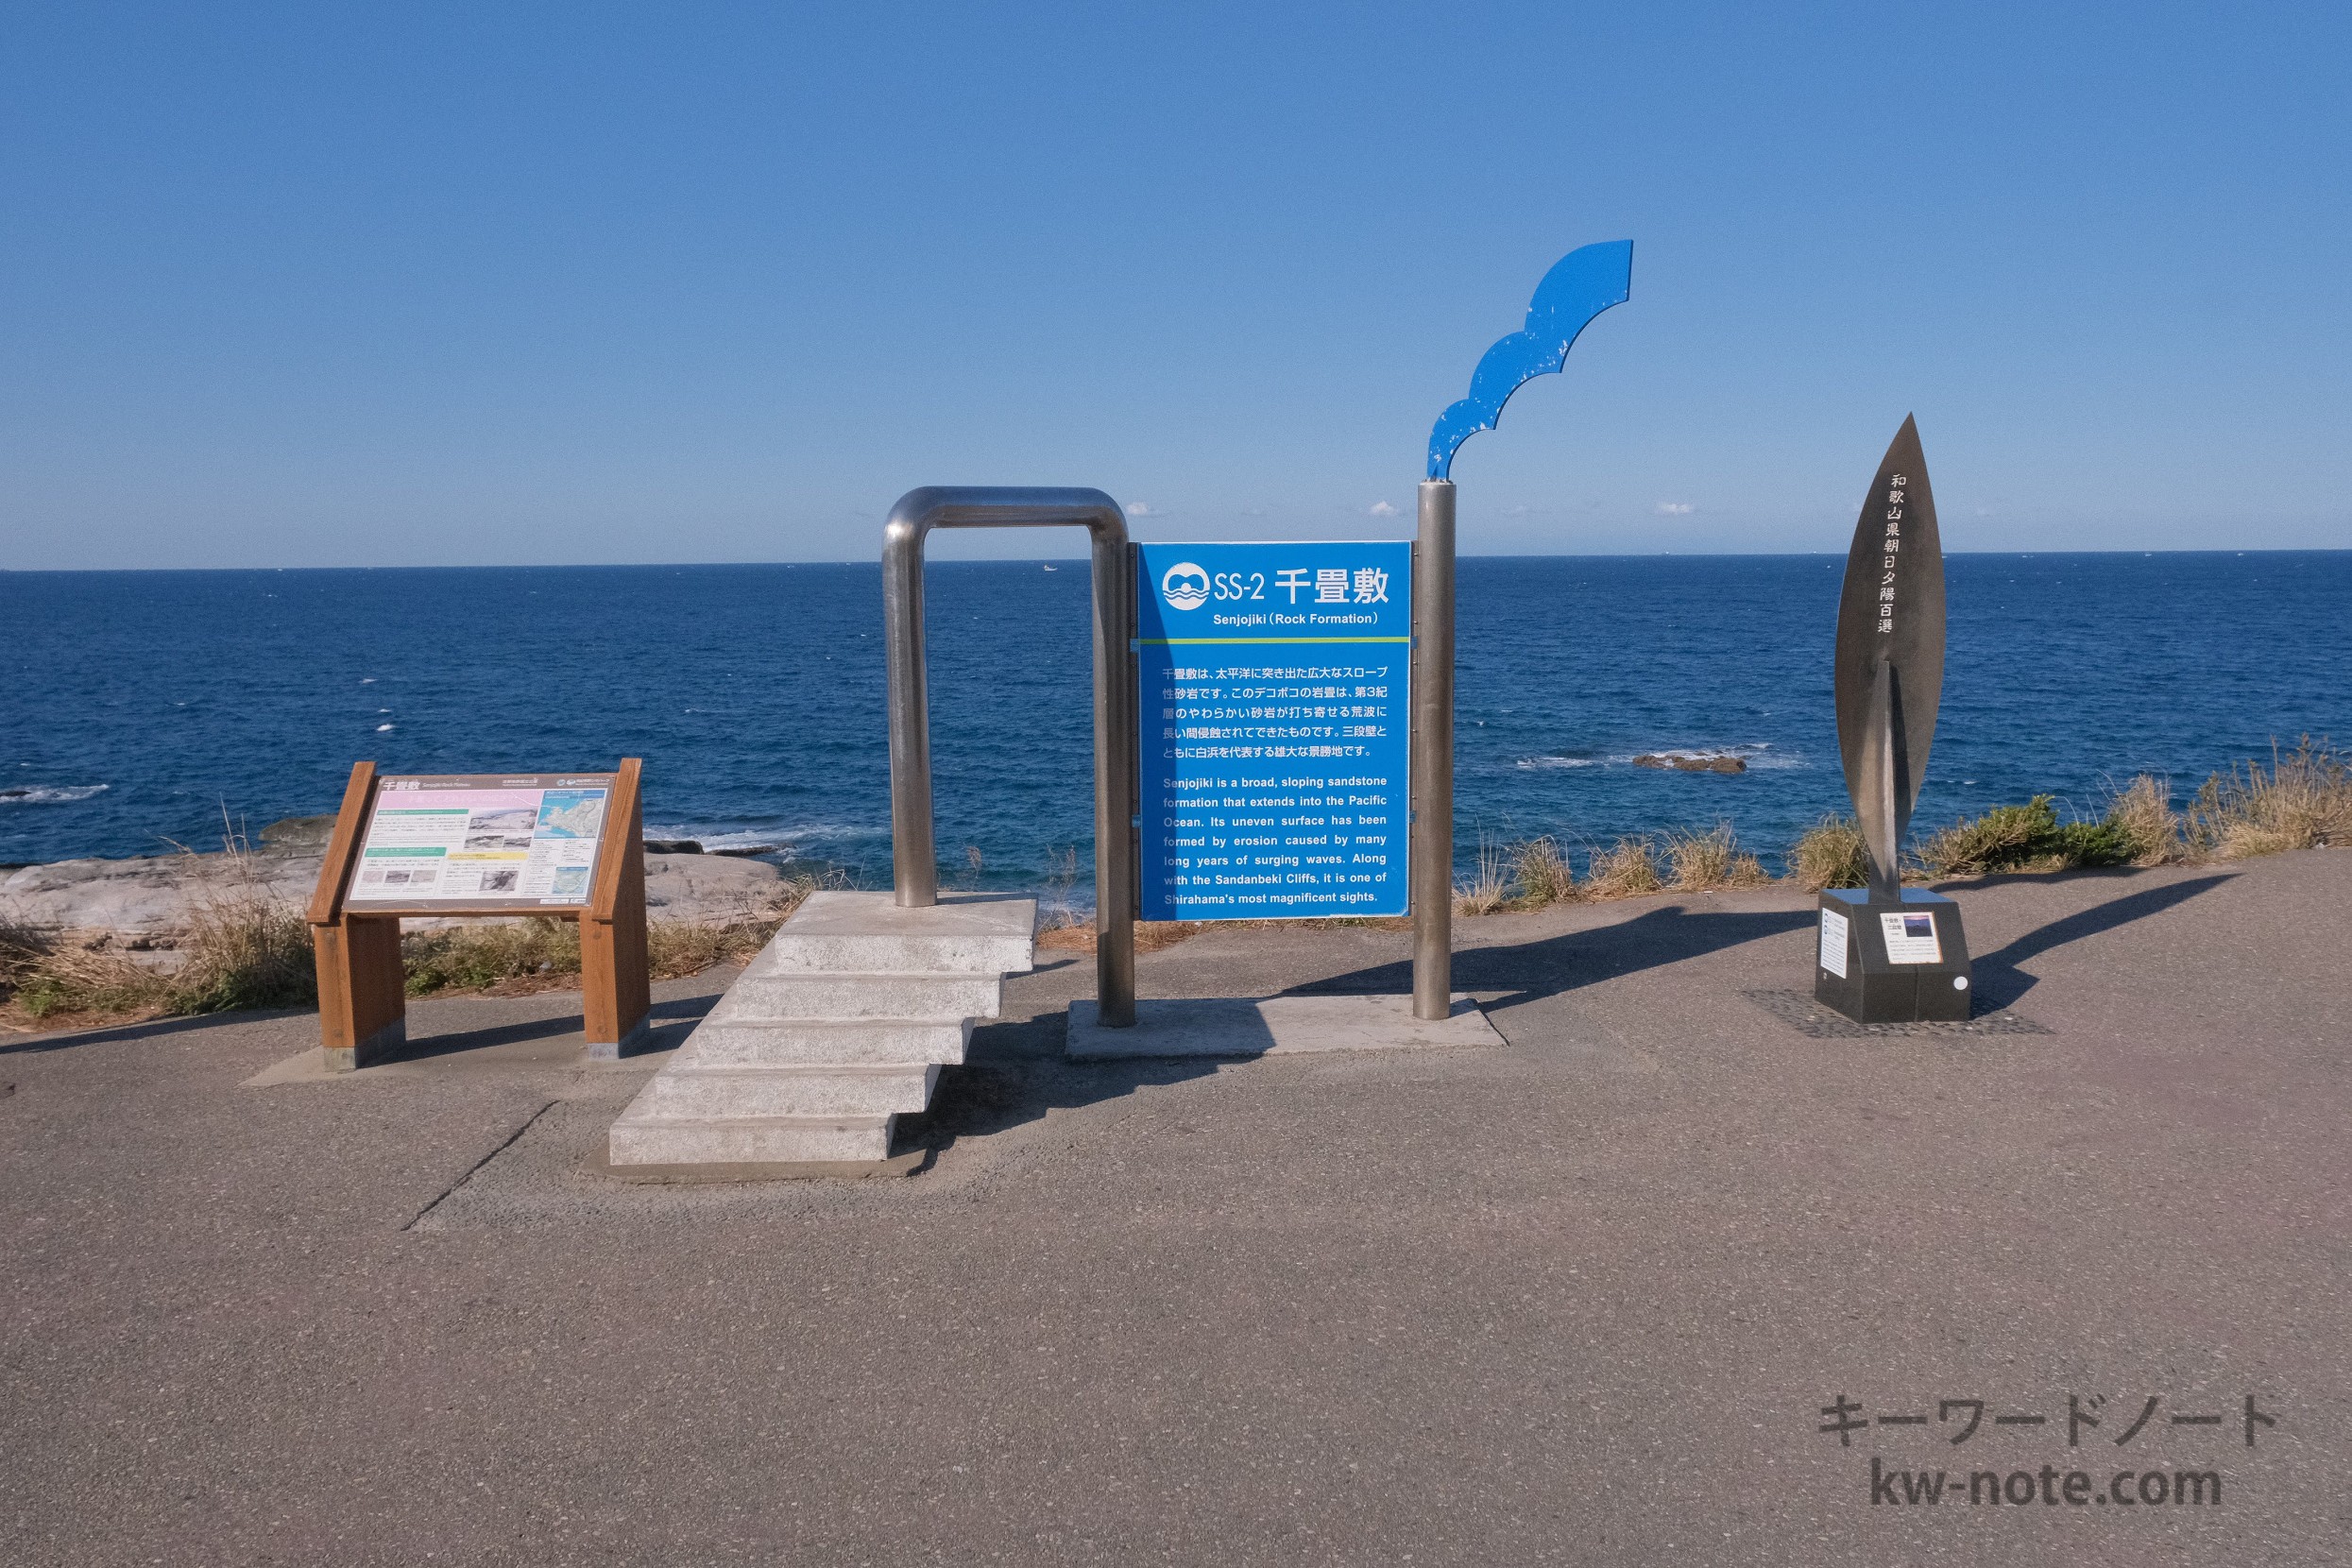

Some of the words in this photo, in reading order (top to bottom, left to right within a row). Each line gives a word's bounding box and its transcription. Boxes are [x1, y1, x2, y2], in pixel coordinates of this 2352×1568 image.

[1877, 473, 1906, 633] 和歌山県朝日夕陽百選
[1214, 572, 1264, 600] SS-2
[1275, 568, 1389, 604] 千畳敷
[1214, 614, 1266, 626] Senjojiki
[1163, 745, 1370, 758] ともに白浜を代表する雄大な景勝地です。
[1163, 778, 1213, 790] Senjojiki
[1218, 778, 1227, 787] is
[1242, 777, 1277, 788] broad,
[1282, 776, 1323, 789] sloping
[1328, 776, 1387, 786] sandstone
[1163, 797, 1218, 808] formation
[1223, 797, 1245, 807] that
[1251, 796, 1295, 807] extends
[1301, 796, 1321, 806] into
[1326, 796, 1344, 806] the
[1349, 795, 1387, 805] Pacific
[1164, 818, 1203, 827] Ocean.
[1211, 817, 1225, 827] Its
[1282, 816, 1324, 826] surface
[1332, 815, 1352, 825] has
[1359, 815, 1386, 824] been
[1163, 837, 1204, 846] formed
[1213, 836, 1226, 848] by
[1234, 836, 1277, 845] erosion
[1286, 835, 1326, 844] caused
[1335, 835, 1348, 846] by
[1356, 836, 1387, 845] many
[1164, 858, 1189, 868] long
[1197, 858, 1228, 868] years
[1236, 855, 1248, 864] of
[1255, 855, 1299, 866] surging
[1353, 854, 1386, 865] Along
[1164, 876, 1187, 885] with
[1193, 876, 1210, 884] the
[1216, 874, 1281, 884] Sandanbeki
[1287, 874, 1319, 884] Cliffs,
[1324, 874, 1331, 882] it
[1336, 873, 1345, 882] is
[1375, 872, 1387, 881] of
[1165, 895, 1235, 904] Shirahama's
[1238, 894, 1267, 904] most
[1270, 893, 1337, 906] magnificent
[1340, 892, 1377, 904] sights.
